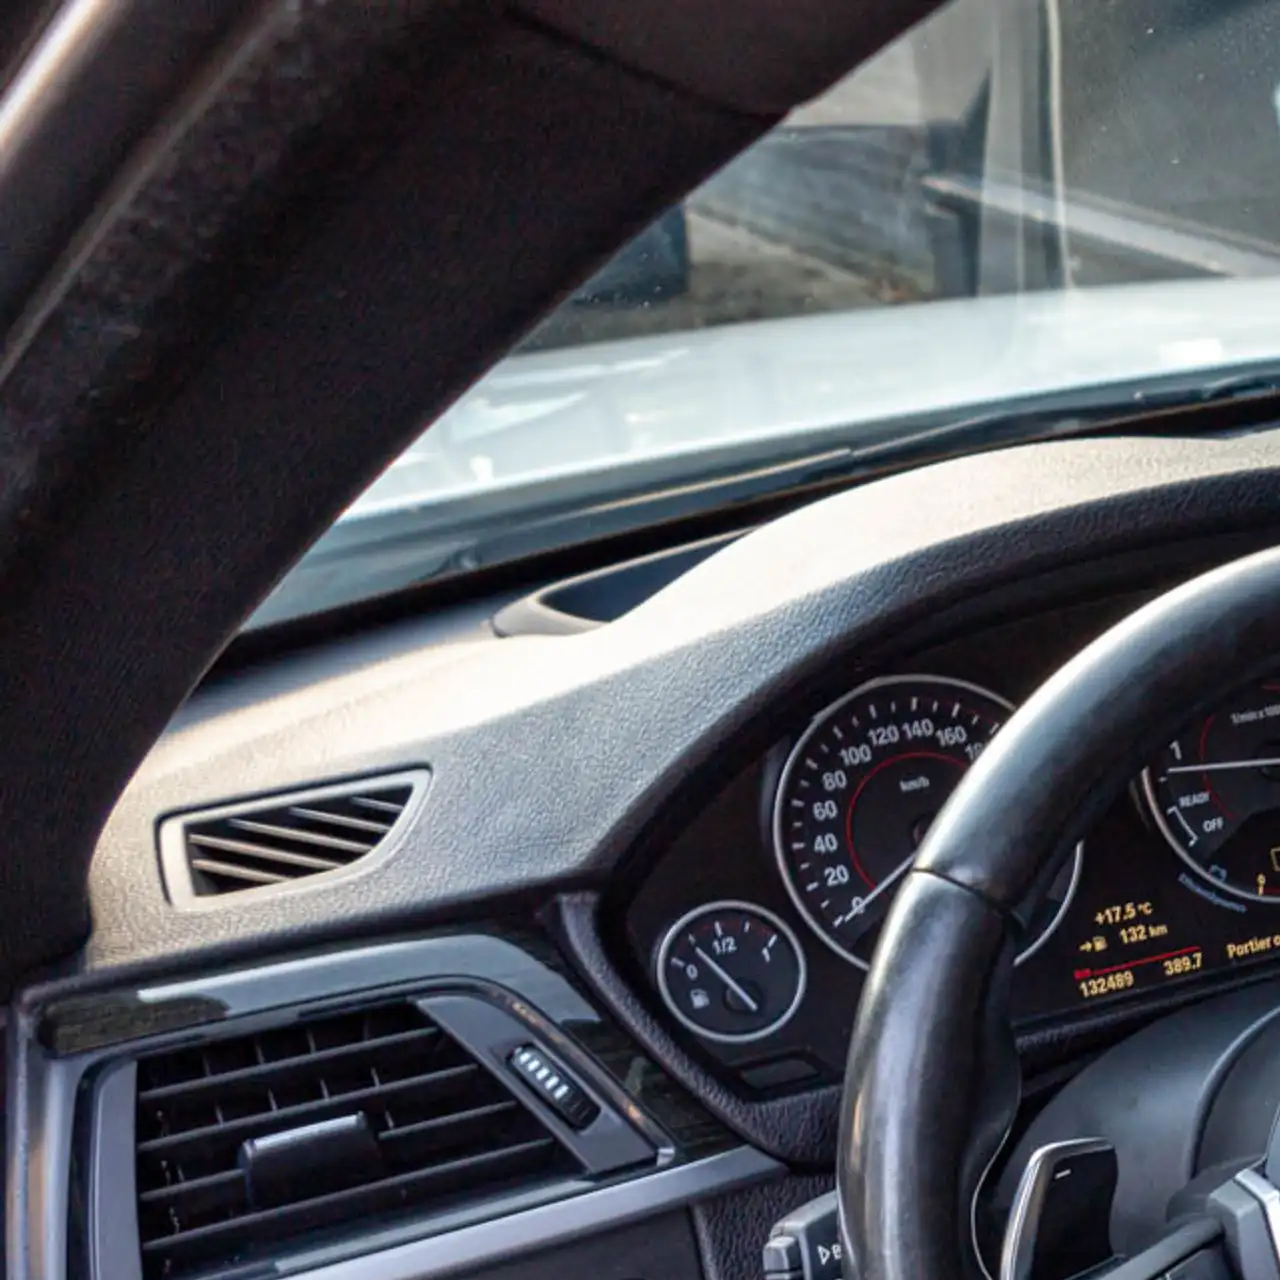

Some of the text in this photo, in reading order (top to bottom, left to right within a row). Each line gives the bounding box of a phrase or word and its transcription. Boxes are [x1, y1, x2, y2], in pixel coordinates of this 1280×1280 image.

[868, 725, 899, 746] 120
[902, 719, 934, 739] 140
[935, 725, 967, 747] 160
[840, 745, 872, 765] 100
[823, 770, 847, 791] 80
[813, 800, 837, 820] 60
[1202, 816, 1223, 832] OFF
[813, 833, 838, 853] 40
[824, 865, 848, 886] 20
[1120, 924, 1168, 944] 132 km
[1227, 935, 1272, 959] Portier
[686, 964, 698, 980] 0
[1163, 952, 1202, 976] 389.7
